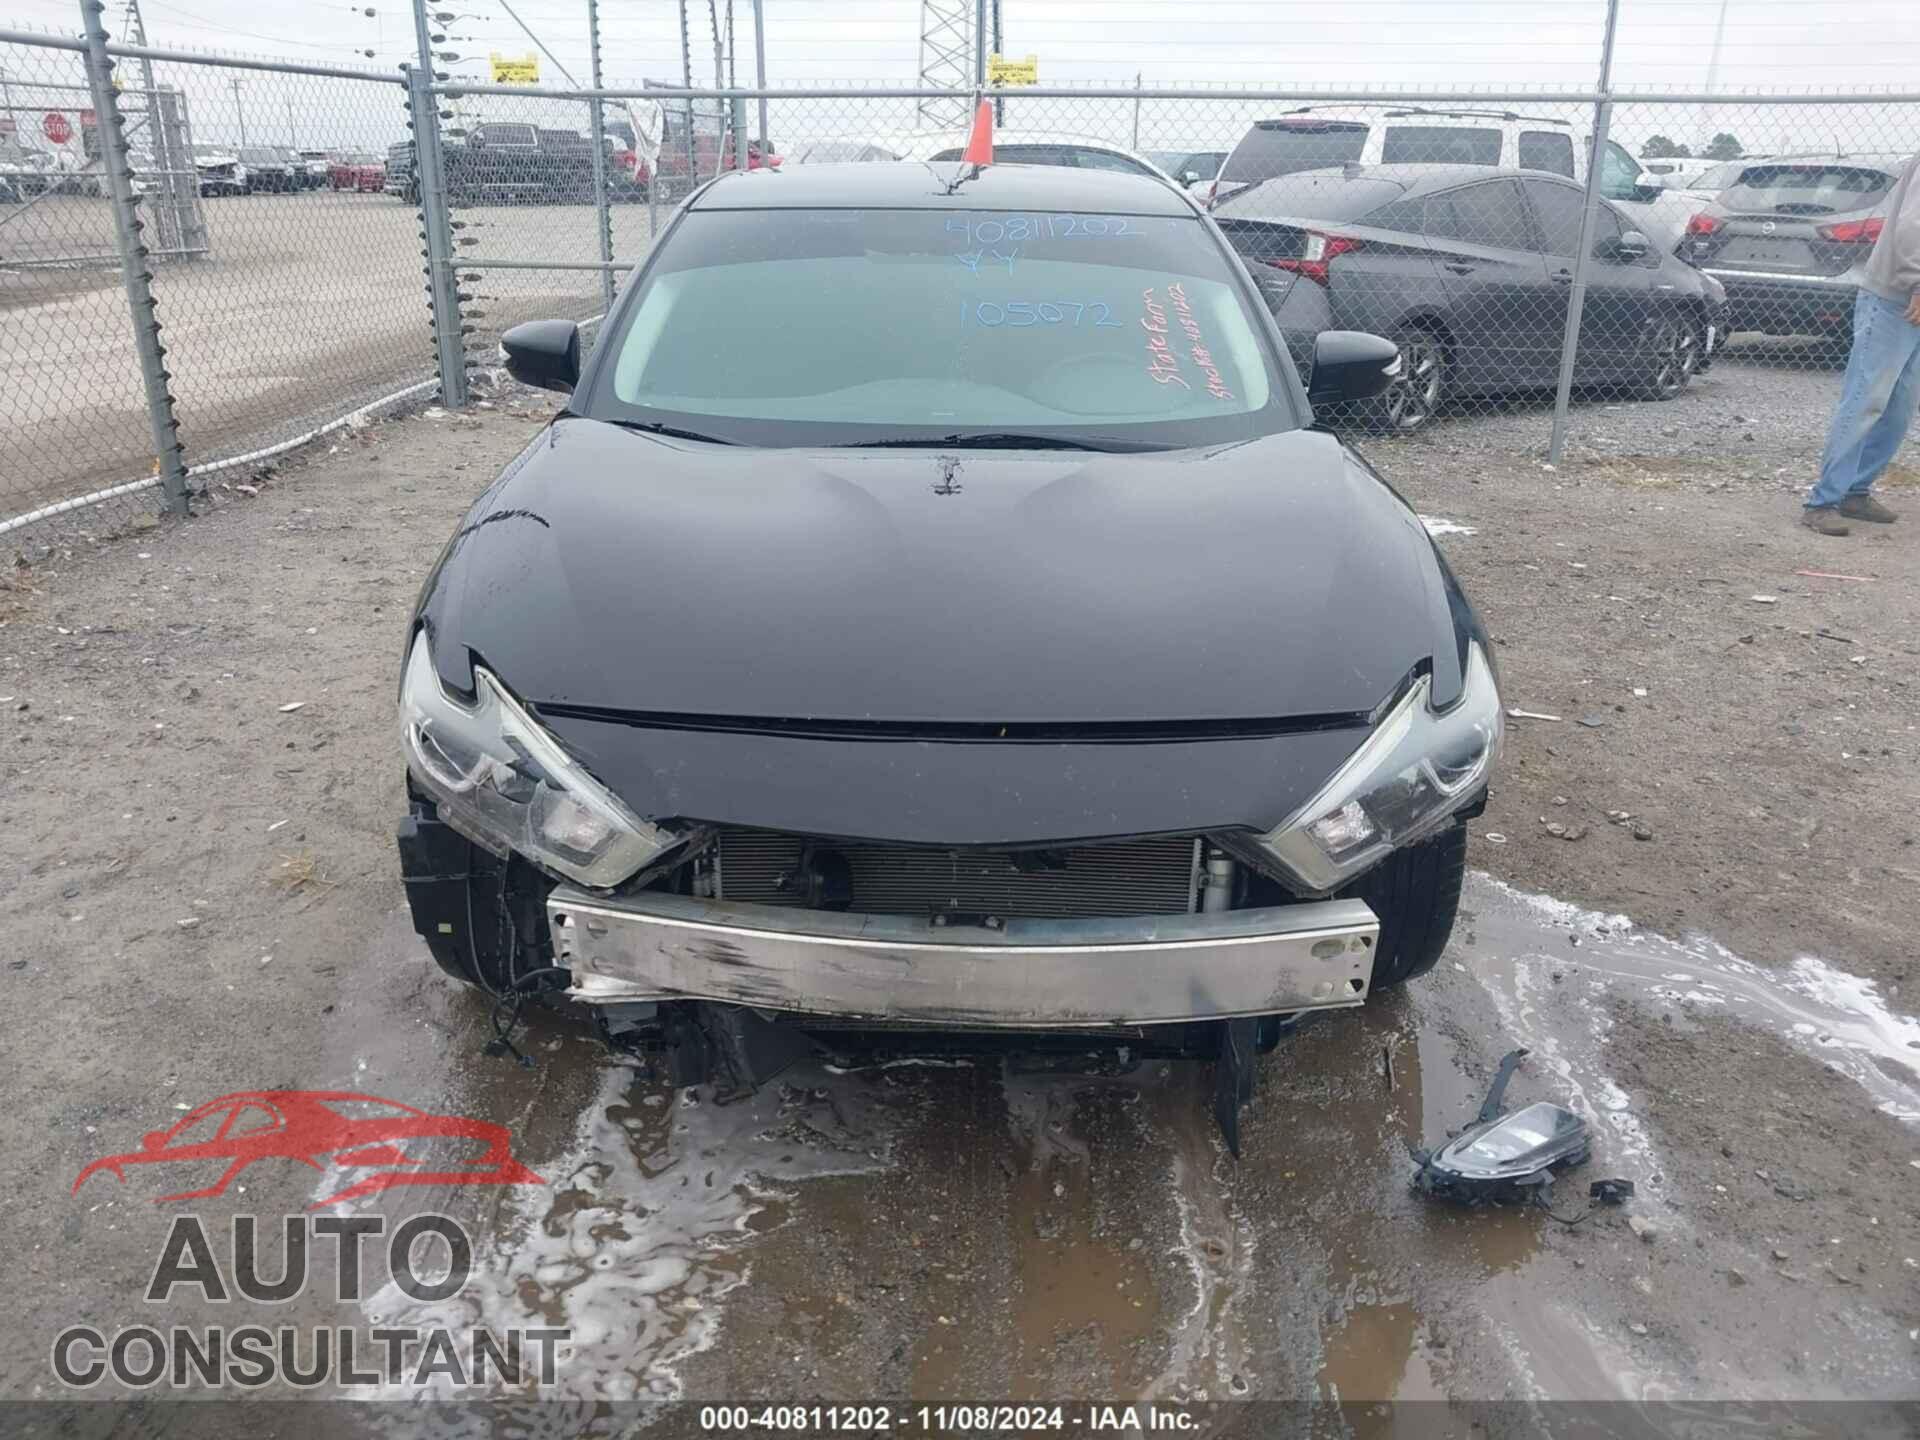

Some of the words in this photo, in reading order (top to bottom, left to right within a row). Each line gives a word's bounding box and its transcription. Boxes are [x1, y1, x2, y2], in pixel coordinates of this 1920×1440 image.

[45, 123, 71, 136] STOP
[944, 217, 1147, 245] 40811202
[960, 301, 1123, 328] 105072
[1140, 287, 1169, 334] Farm
[1145, 335, 1191, 390] State
